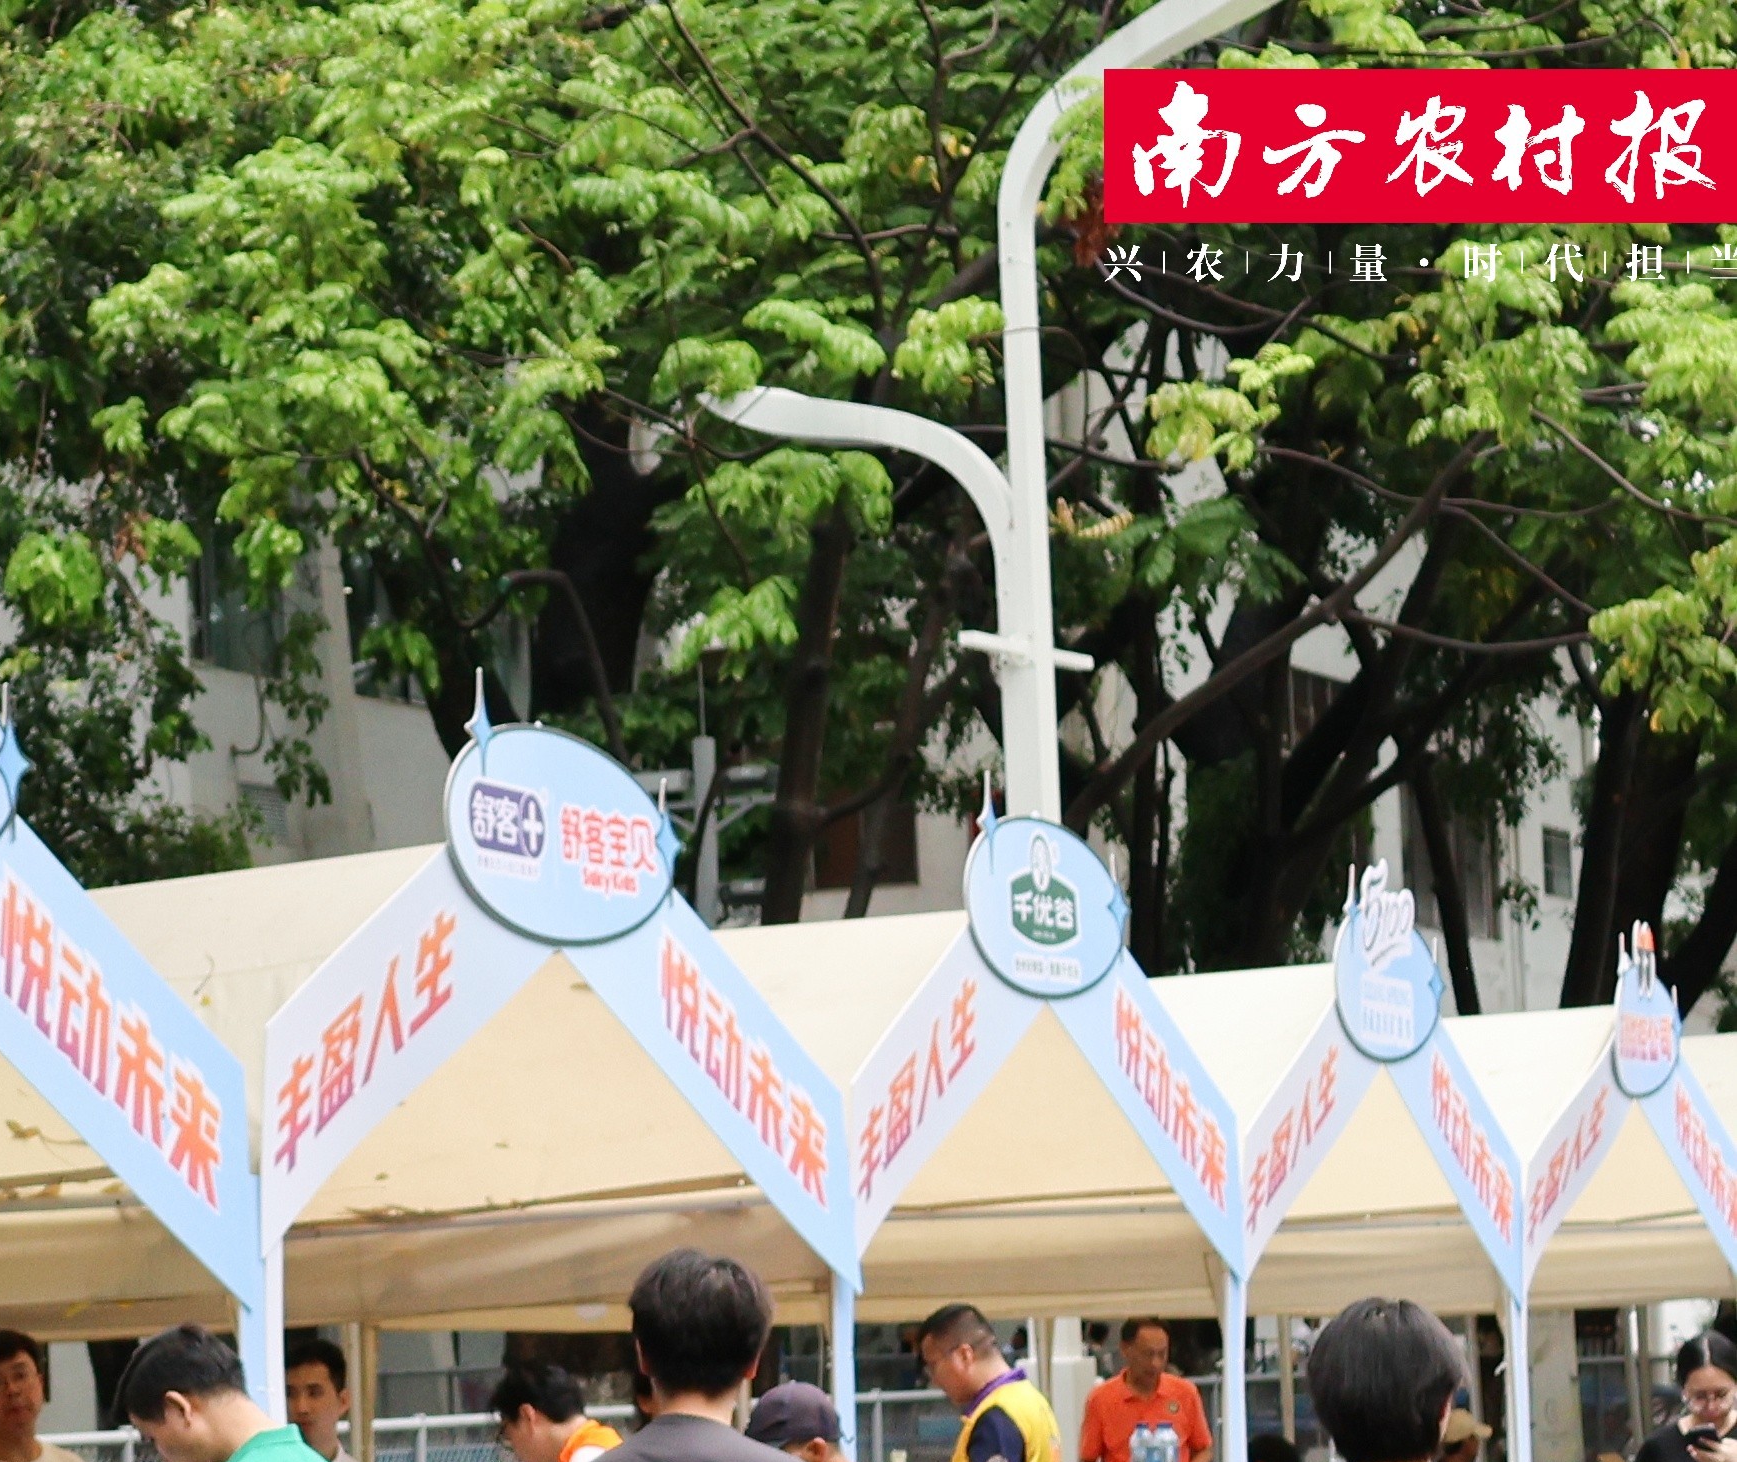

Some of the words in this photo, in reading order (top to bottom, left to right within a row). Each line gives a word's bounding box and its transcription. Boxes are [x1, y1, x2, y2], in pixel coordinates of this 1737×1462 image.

[561, 806, 655, 873] 舒客宝贝
[275, 912, 456, 1172] 丰盈人生
[661, 934, 827, 1208] 悦动未来
[859, 978, 976, 1202] 丰盈人生
[1115, 986, 1226, 1212] 悦动未来
